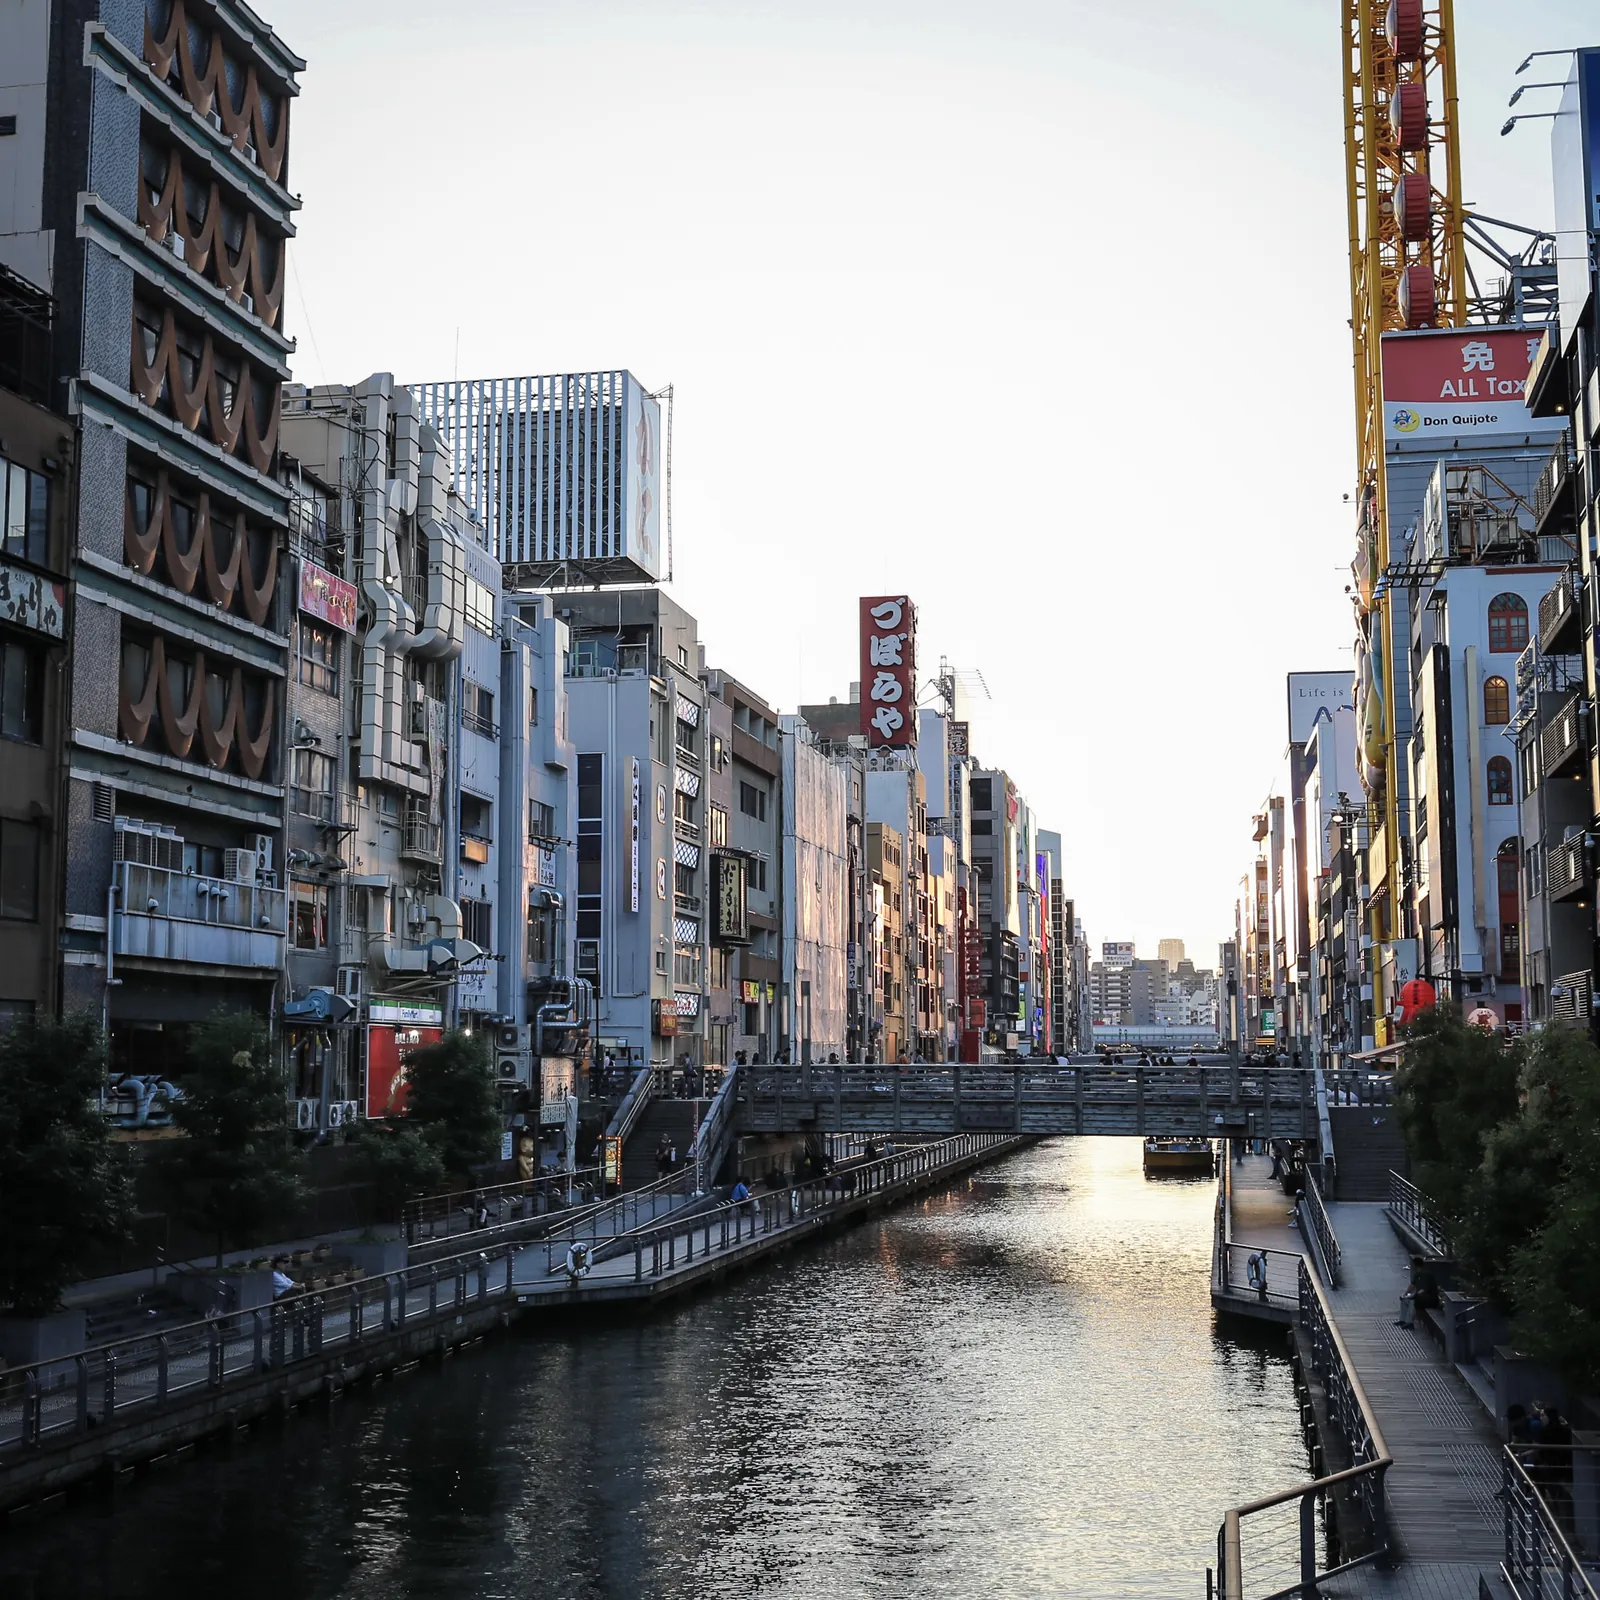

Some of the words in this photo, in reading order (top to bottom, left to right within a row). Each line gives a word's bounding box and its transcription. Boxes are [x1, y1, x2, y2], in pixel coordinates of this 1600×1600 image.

[1439, 378, 1479, 398] ALL
[1486, 376, 1526, 395] Tax
[1423, 416, 1448, 428] Don
[1452, 414, 1499, 426] Quijote
[870, 597, 909, 739] づぼらや
[1298, 688, 1327, 699] Life
[1332, 687, 1345, 698] is
